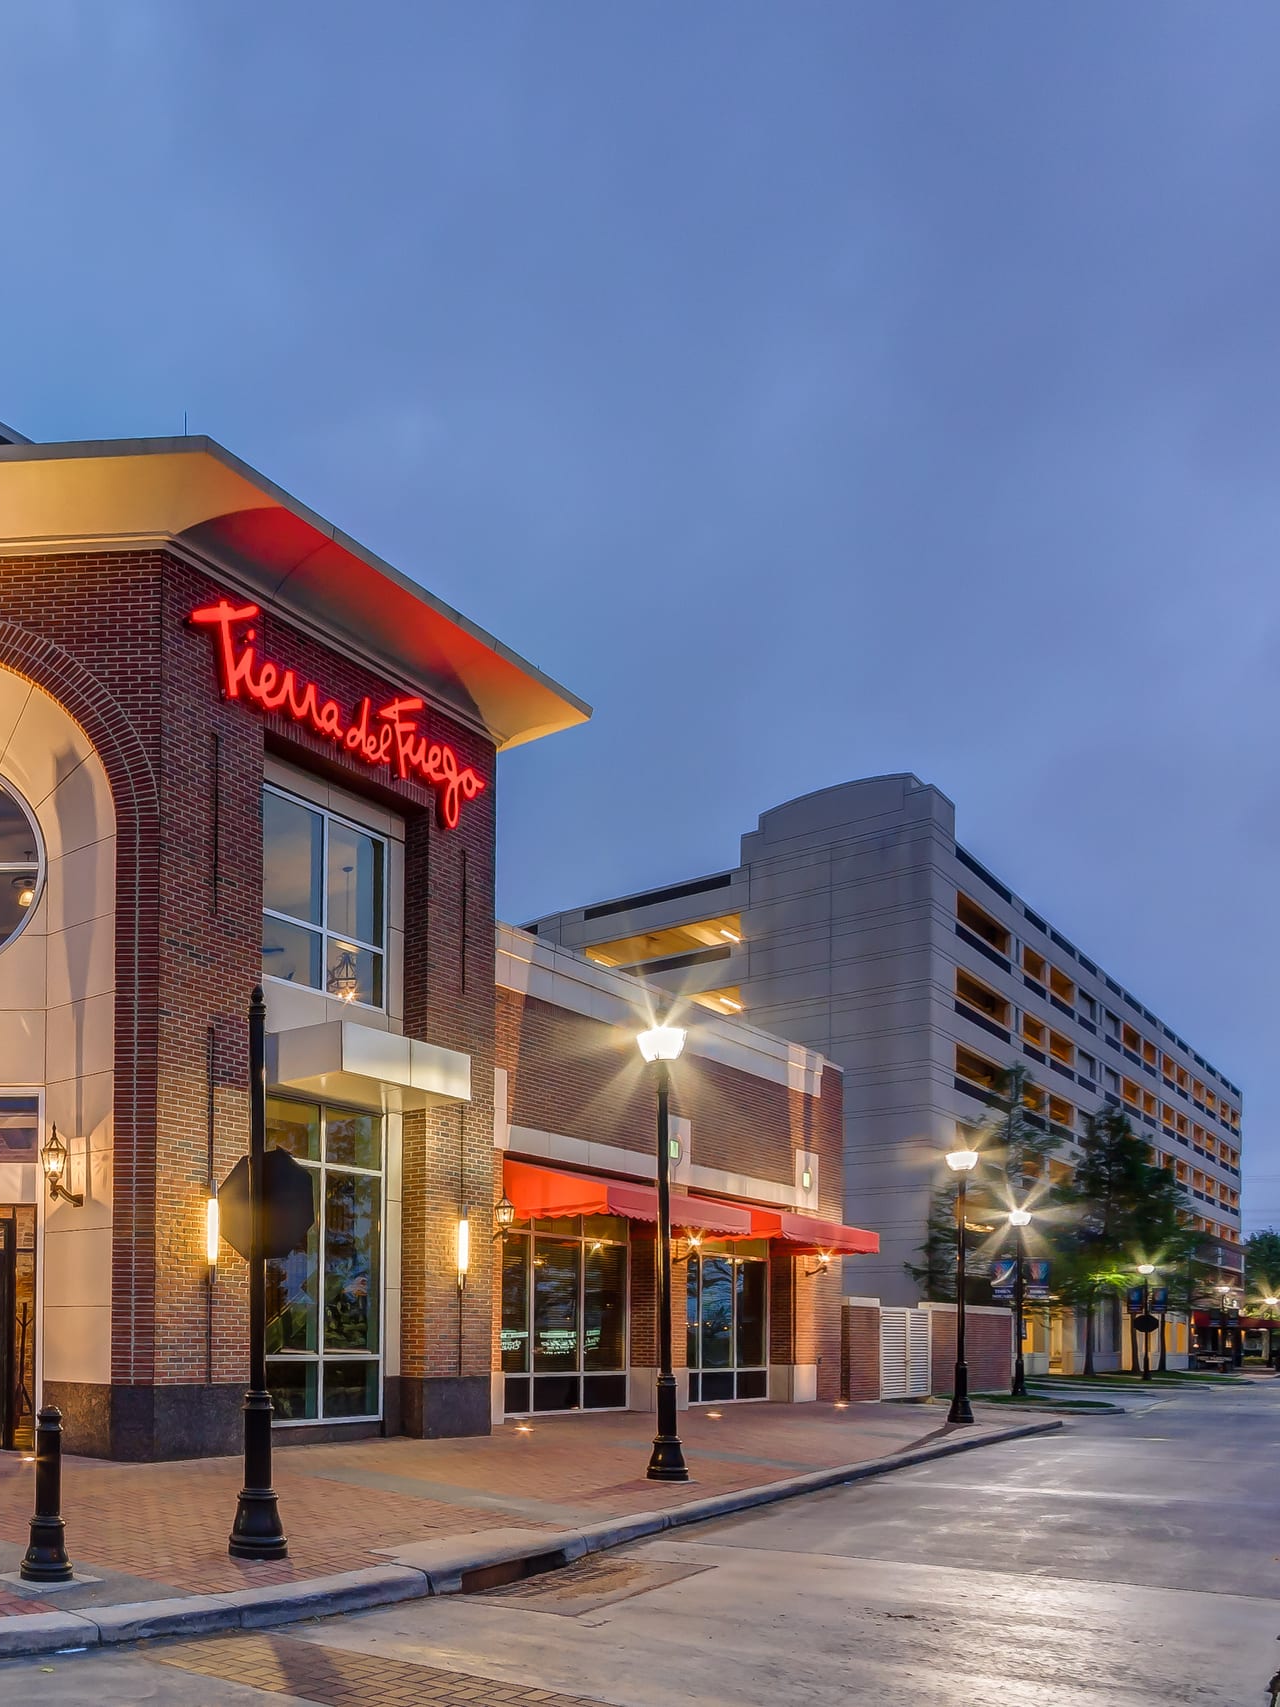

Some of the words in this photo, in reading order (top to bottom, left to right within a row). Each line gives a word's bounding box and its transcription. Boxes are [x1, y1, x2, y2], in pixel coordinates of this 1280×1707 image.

[192, 600, 343, 738] Tierra
[346, 697, 392, 763] del
[379, 697, 485, 829] Fuego
